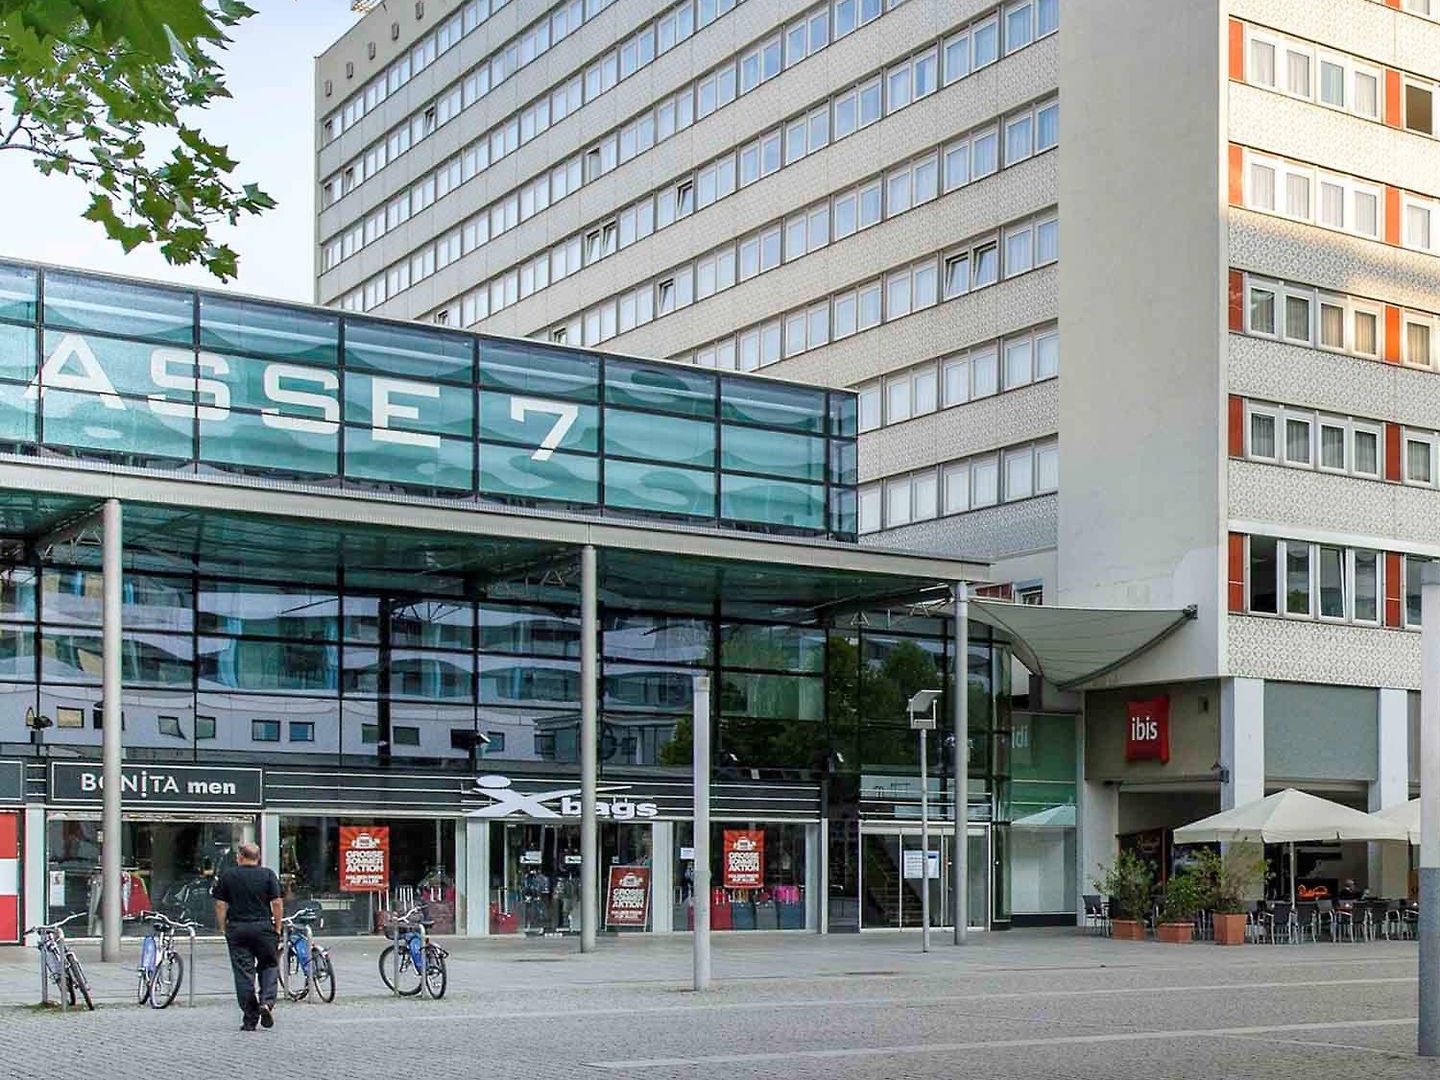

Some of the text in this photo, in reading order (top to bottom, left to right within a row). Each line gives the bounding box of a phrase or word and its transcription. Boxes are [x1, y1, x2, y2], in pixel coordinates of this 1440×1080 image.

[20, 333, 579, 462] ASSE 7
[1131, 716, 1158, 741] ibis
[80, 770, 236, 798] BNiTA men
[346, 864, 384, 872] AKTION
